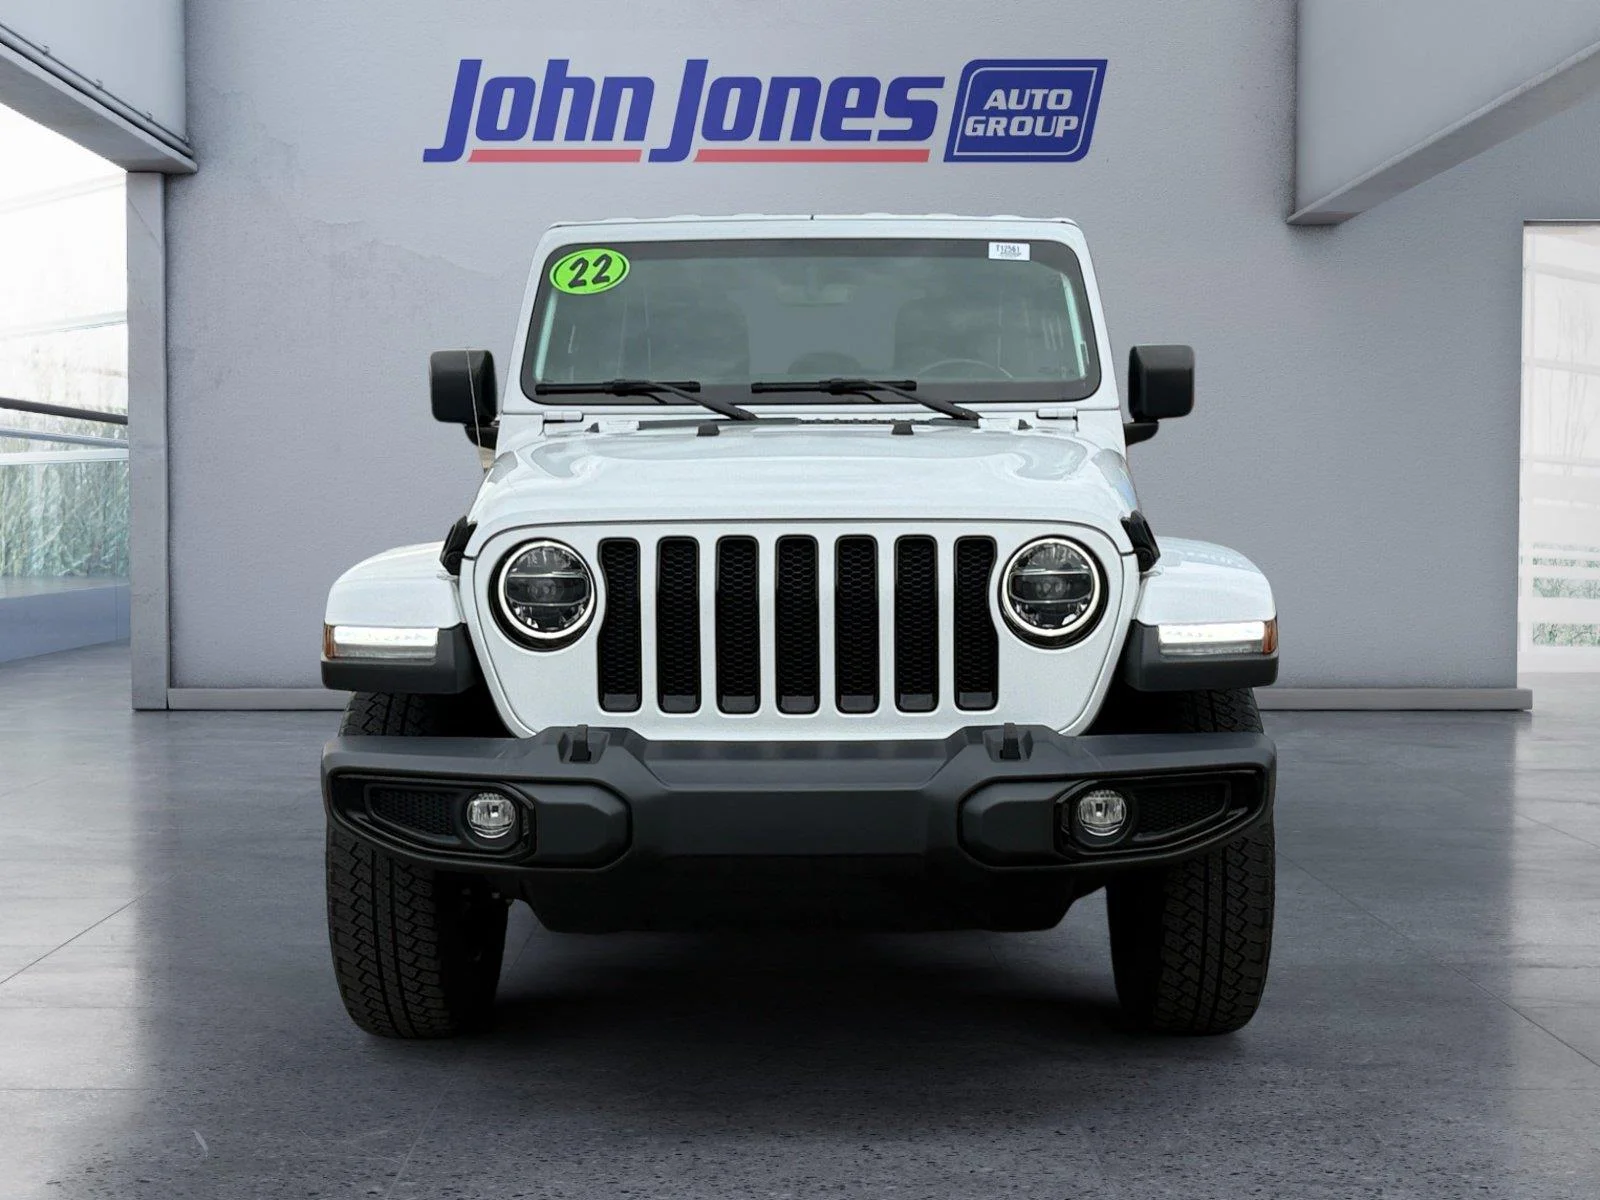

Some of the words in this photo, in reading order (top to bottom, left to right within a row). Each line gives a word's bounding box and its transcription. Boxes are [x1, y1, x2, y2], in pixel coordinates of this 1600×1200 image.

[423, 58, 655, 162] John
[648, 58, 946, 162] Jones
[983, 88, 1073, 110] AUTO
[964, 115, 1079, 138] GROUP
[568, 253, 612, 289] 22
